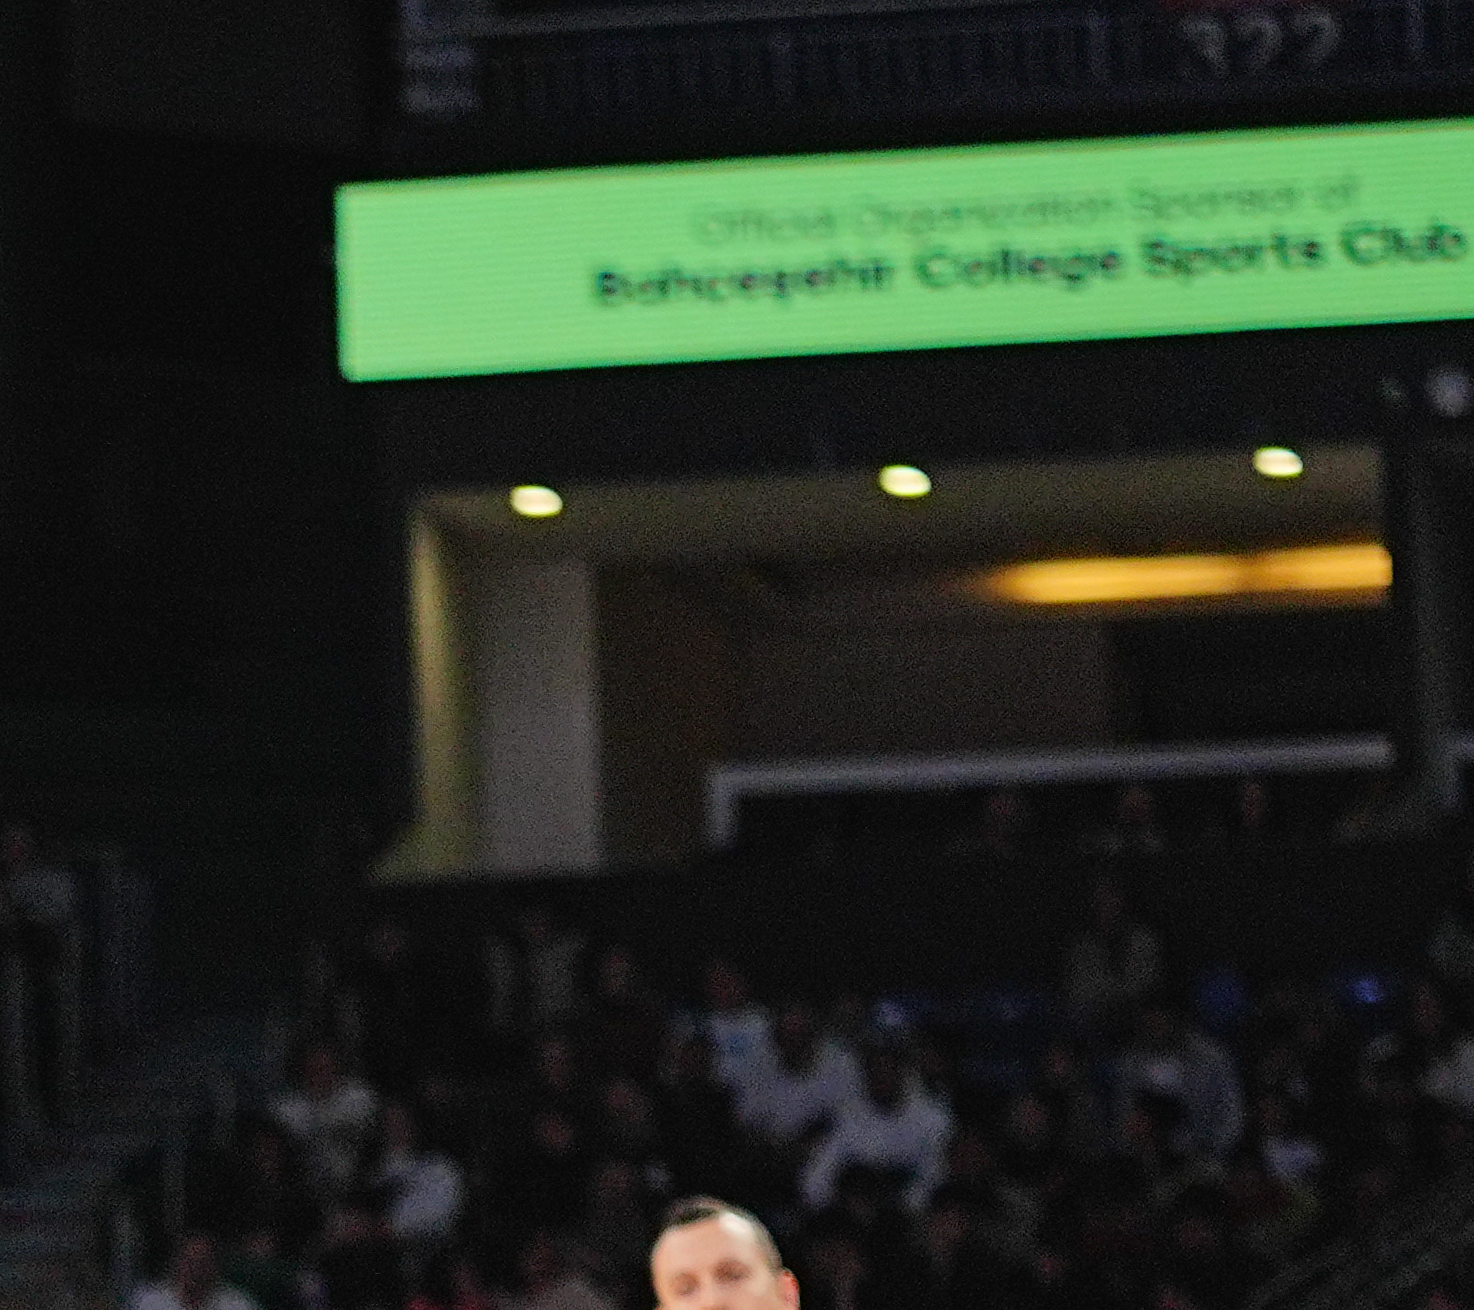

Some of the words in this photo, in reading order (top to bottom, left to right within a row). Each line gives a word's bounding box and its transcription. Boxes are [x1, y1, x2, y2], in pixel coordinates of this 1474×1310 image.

[914, 241, 1125, 290] College
[1141, 230, 1325, 284] Sports
[1339, 218, 1469, 268] Club
